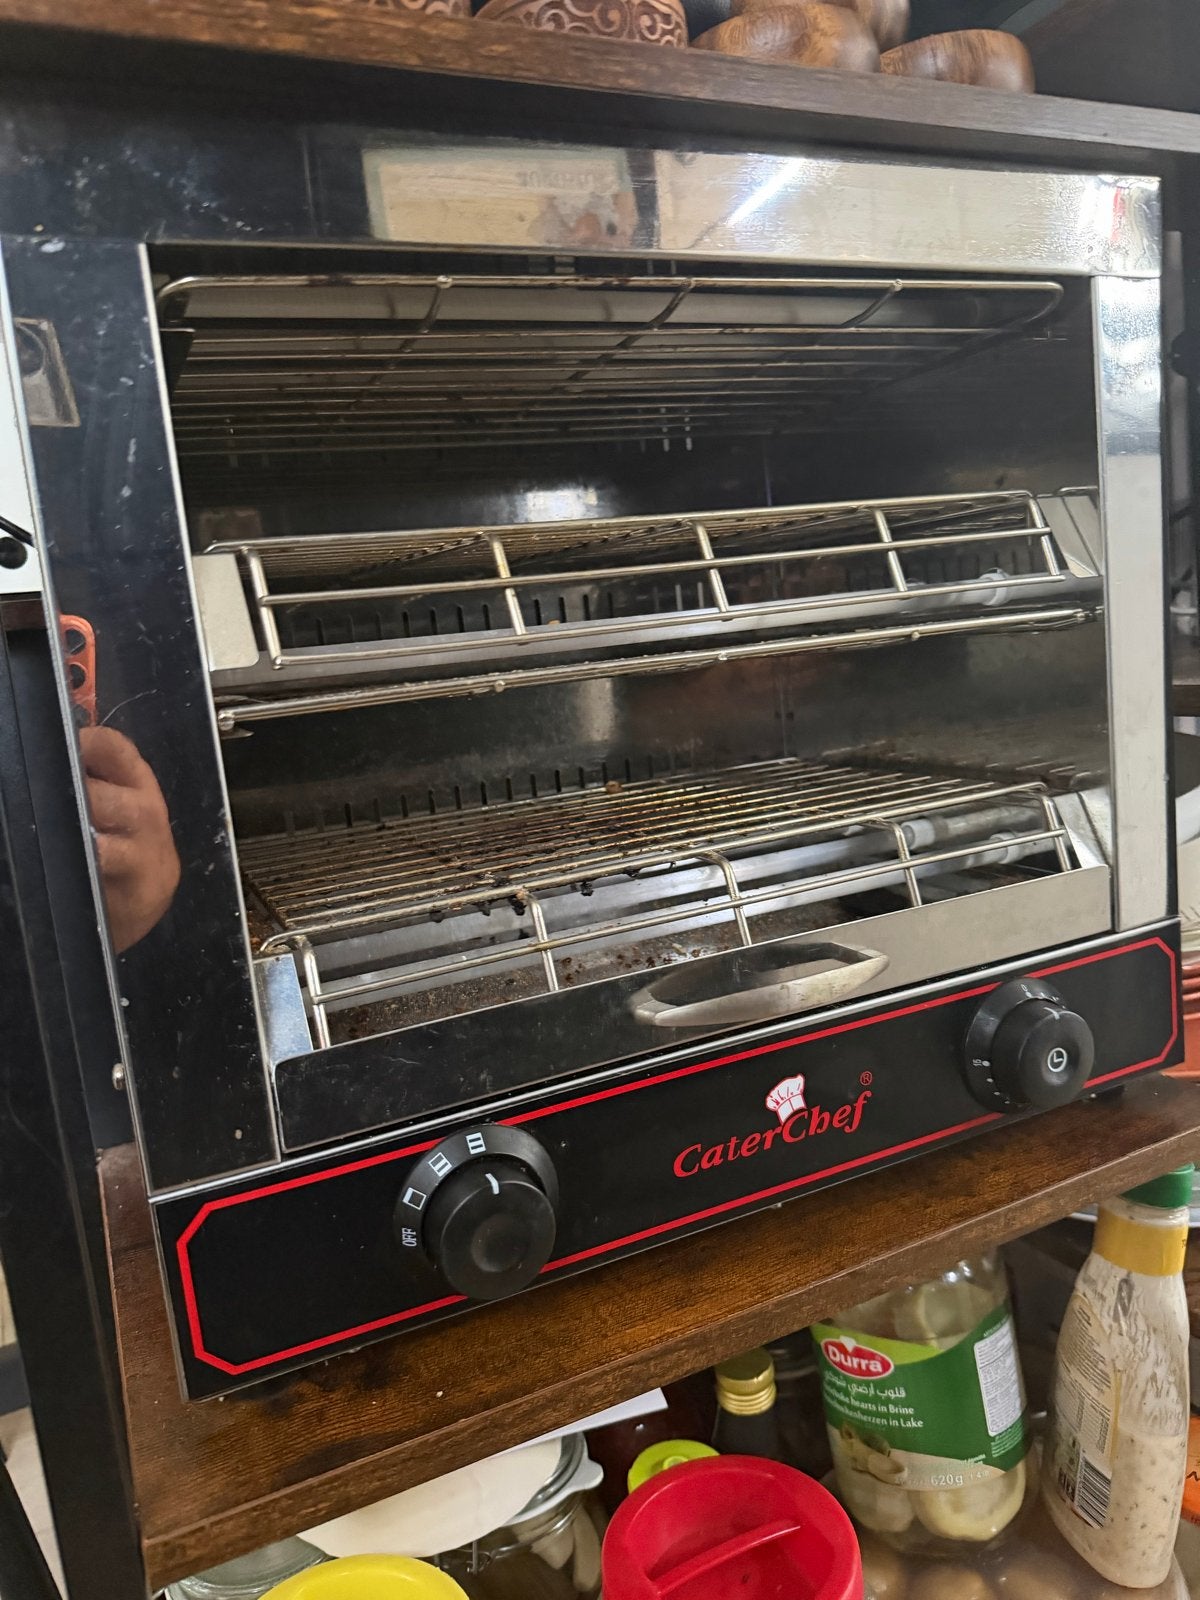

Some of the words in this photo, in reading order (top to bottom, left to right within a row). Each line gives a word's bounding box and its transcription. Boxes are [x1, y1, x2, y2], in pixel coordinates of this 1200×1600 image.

[673, 1090, 872, 1177] CaterChef
[401, 1227, 417, 1247] OFF
[827, 1344, 883, 1373] Durra
[850, 1396, 877, 1412] hearts
[878, 1403, 887, 1413] in
[888, 1403, 915, 1415] Brine
[889, 1417, 899, 1427] in
[900, 1416, 924, 1428] Lake
